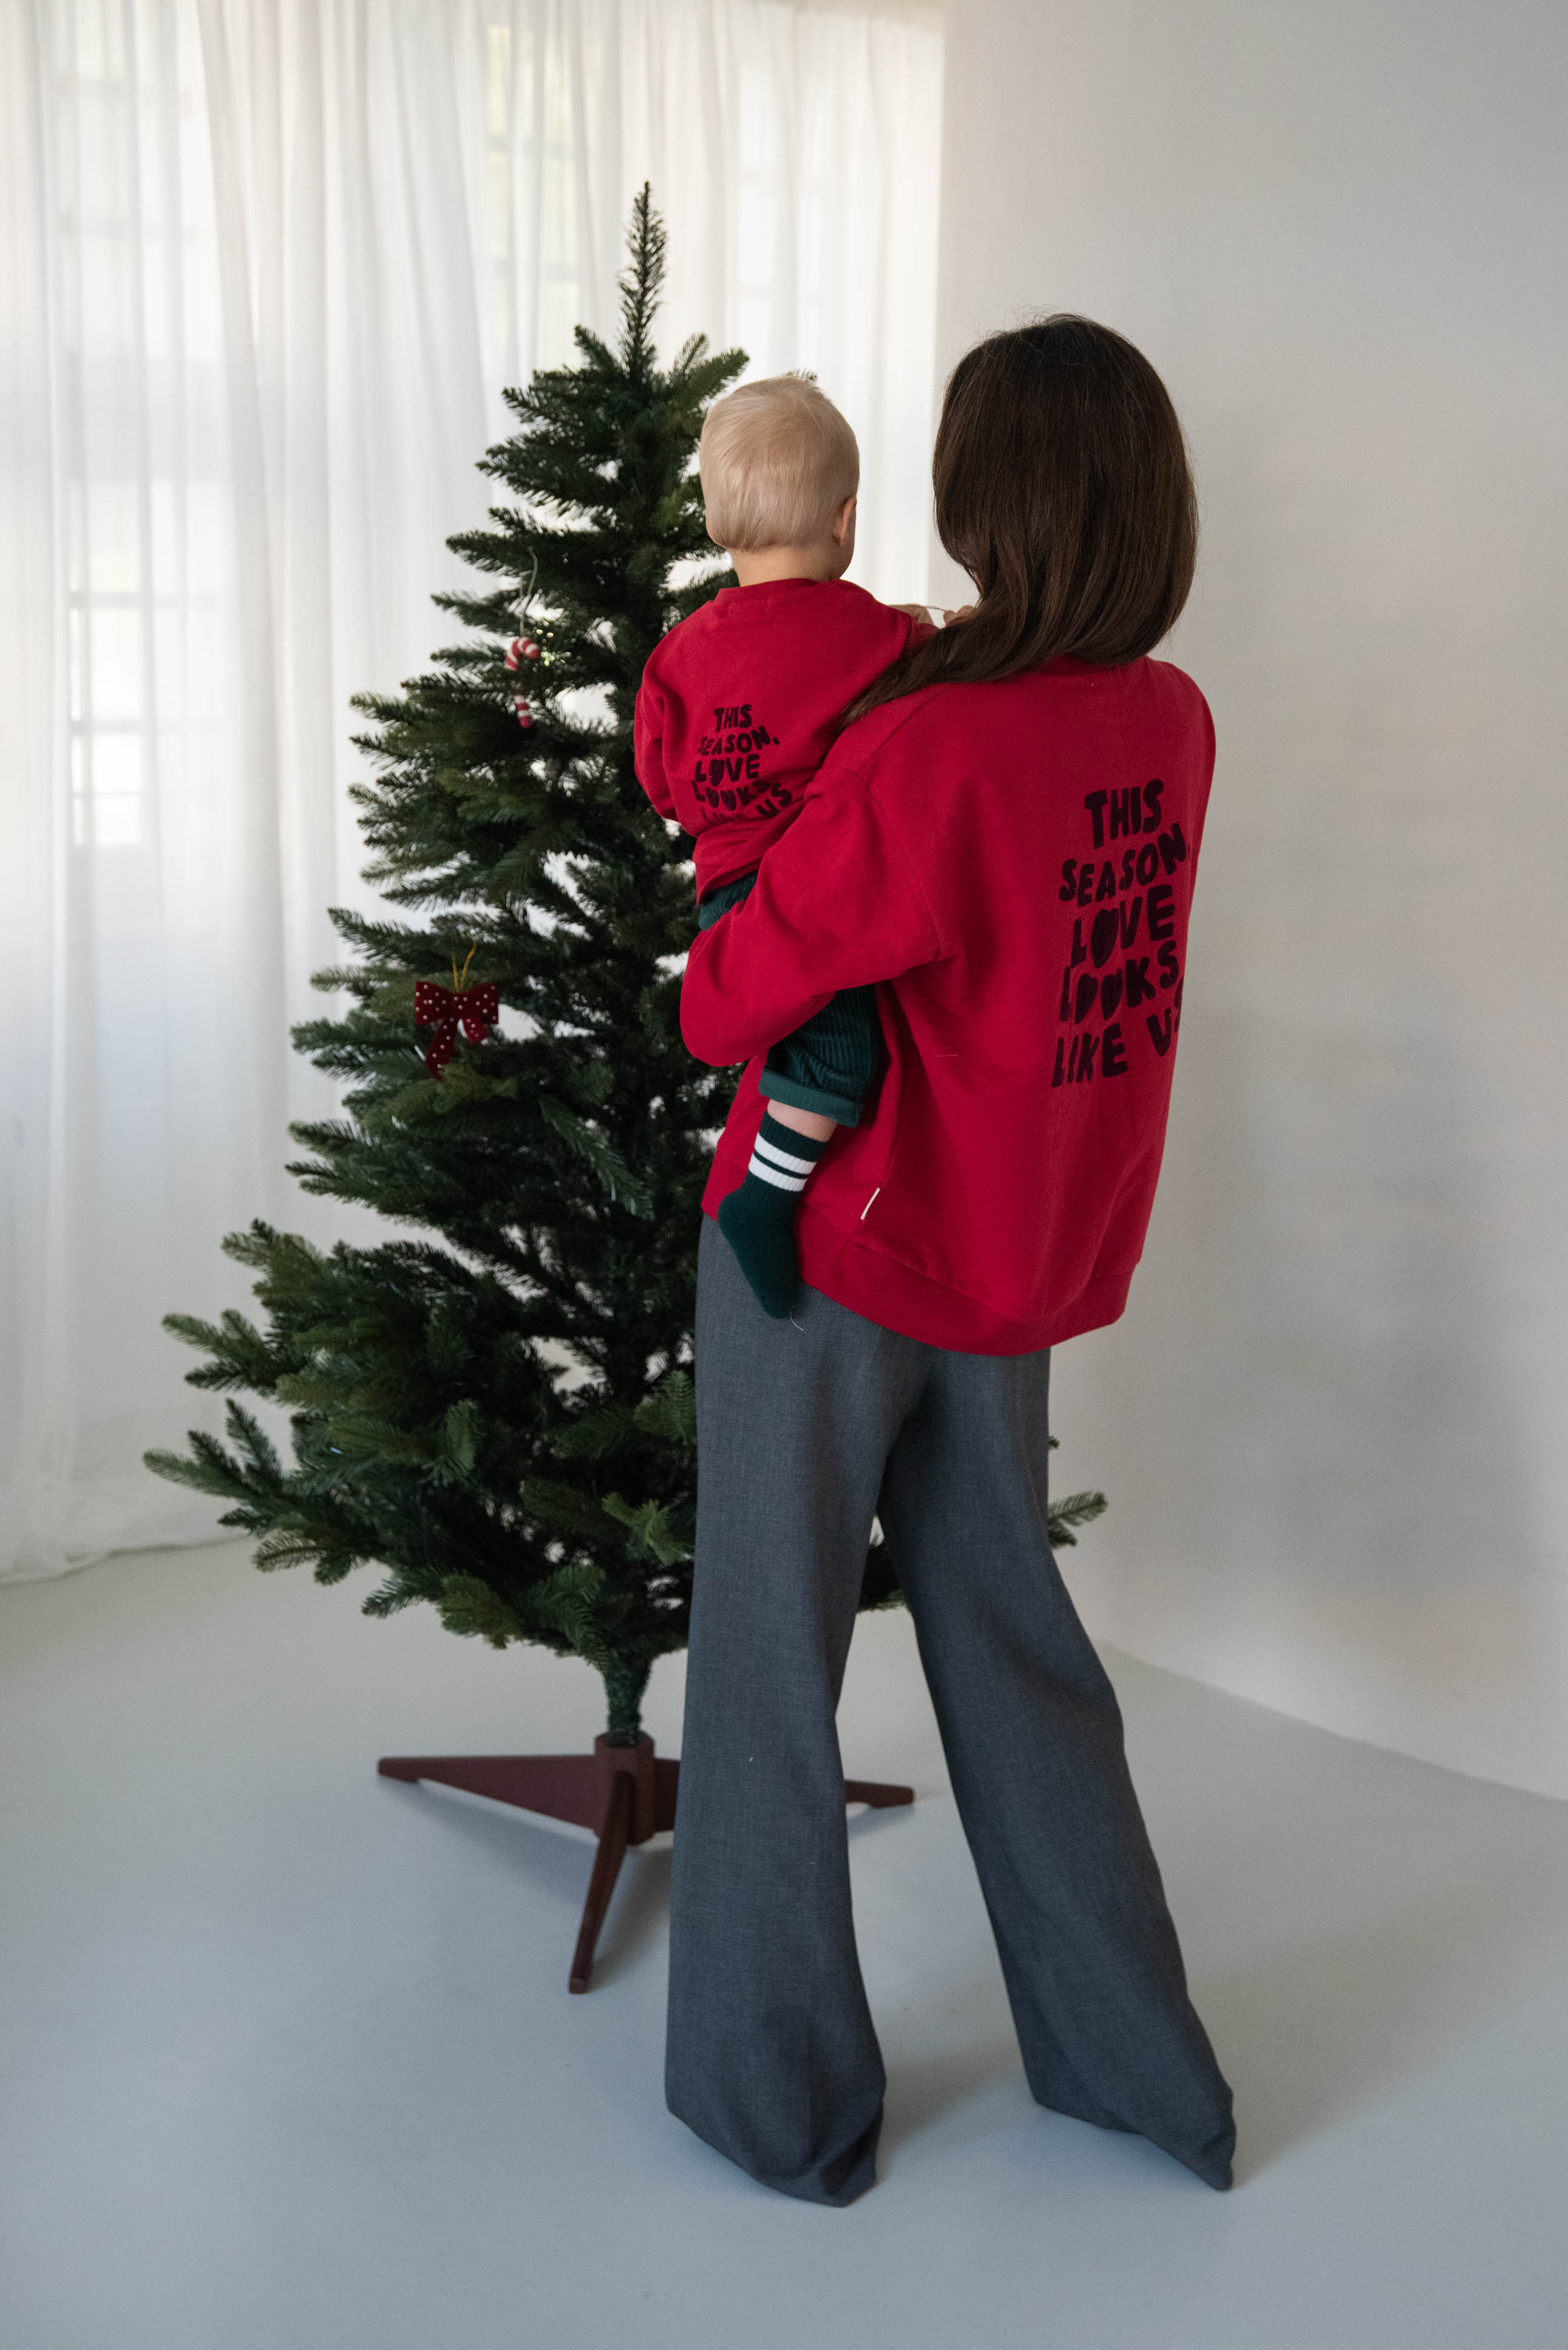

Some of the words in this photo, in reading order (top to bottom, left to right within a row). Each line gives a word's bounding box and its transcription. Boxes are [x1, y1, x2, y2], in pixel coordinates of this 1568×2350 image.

[713, 704, 752, 733] THIS
[694, 754, 760, 786] LOVE
[1084, 778, 1164, 849] THIS
[1071, 885, 1175, 969] LOVE
[1060, 940, 1179, 1025] LOOKS
[1051, 1023, 1128, 1087] LIKE
